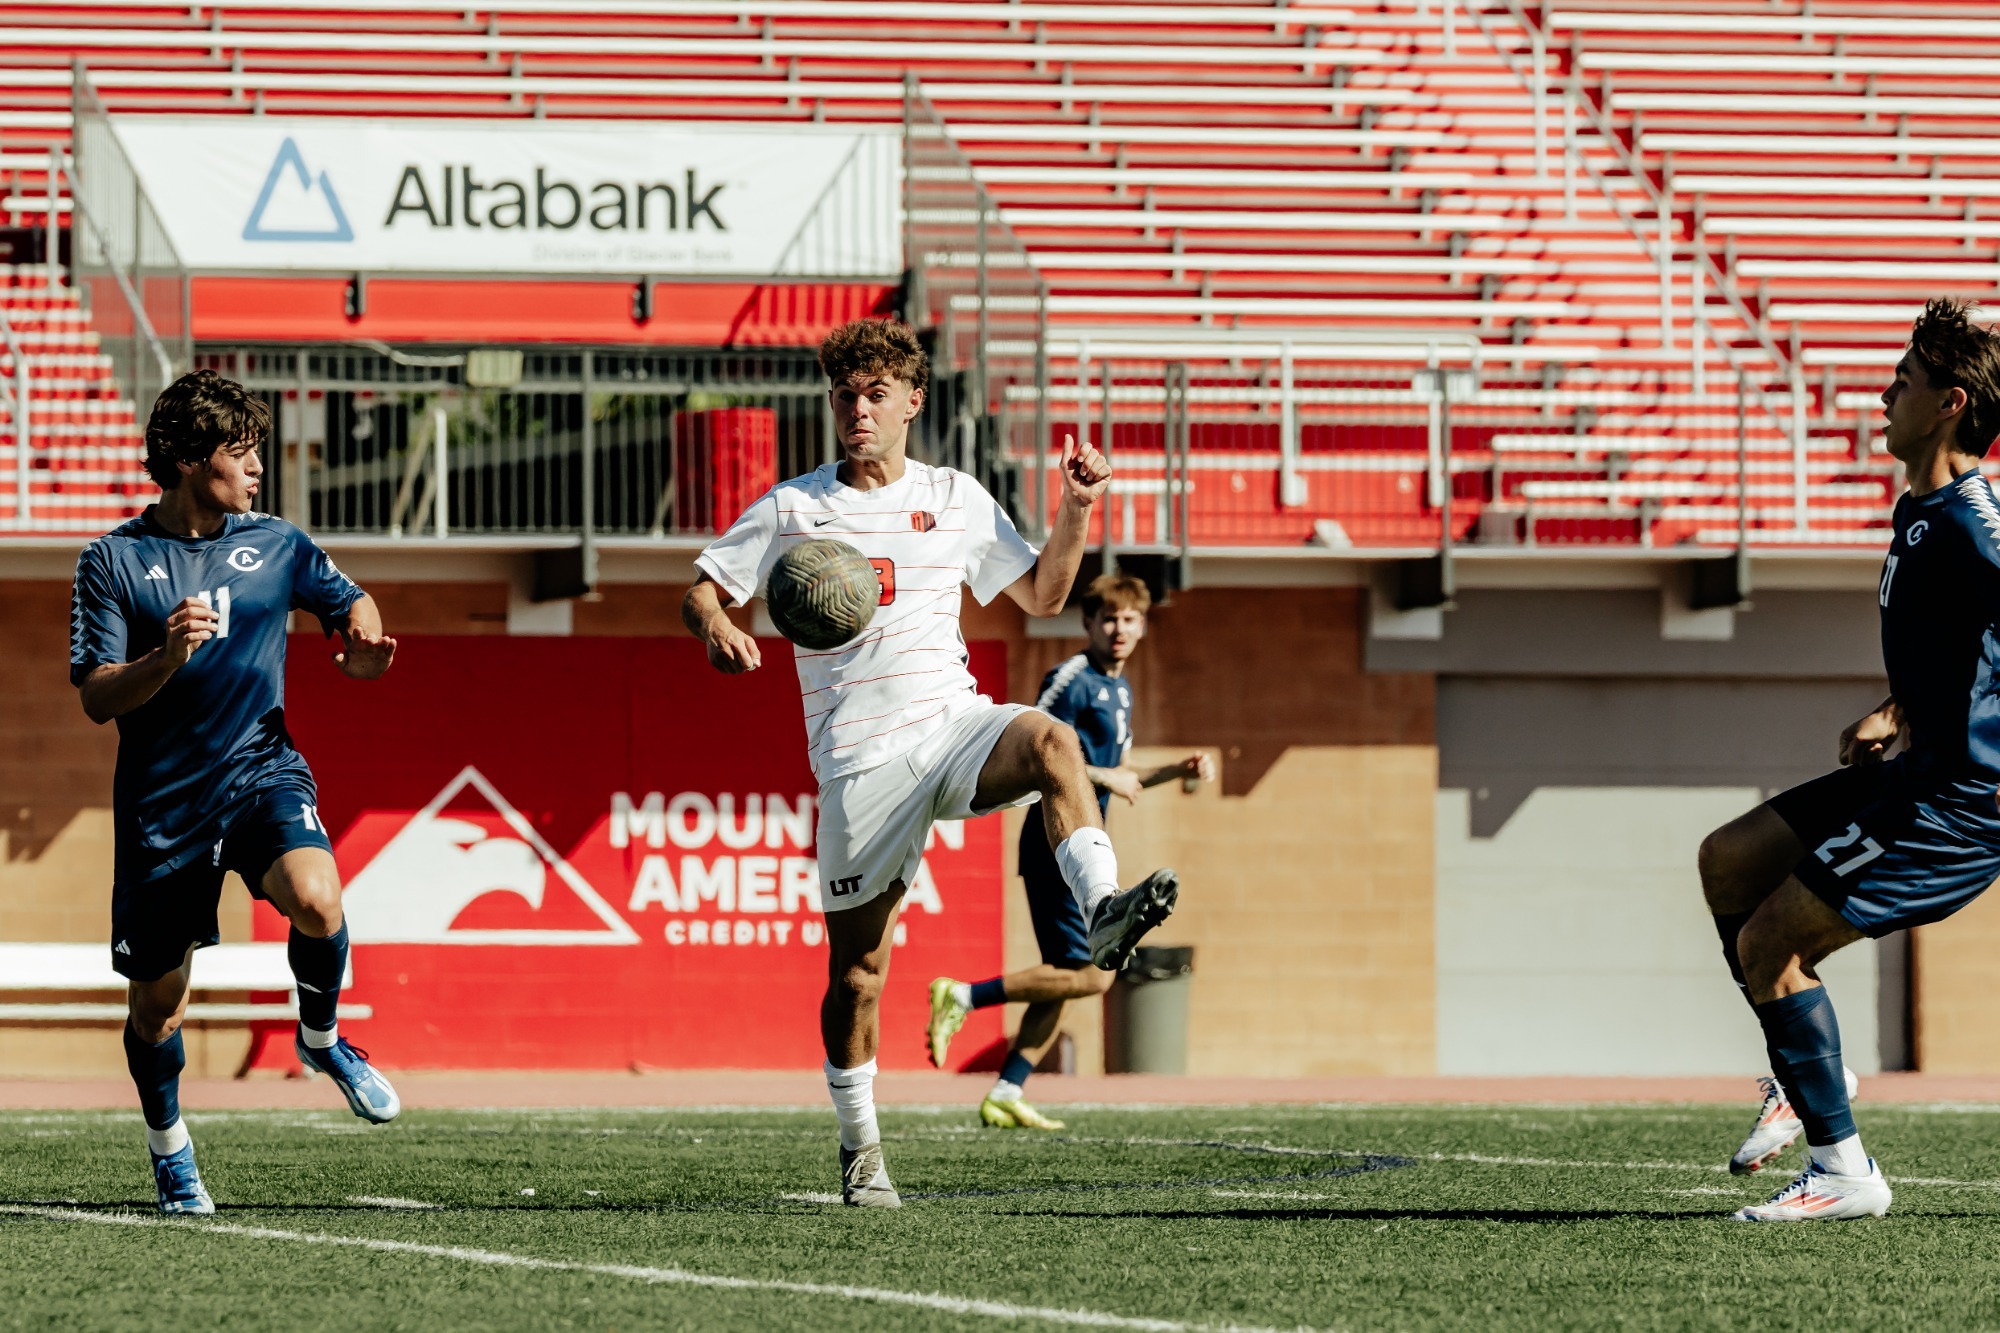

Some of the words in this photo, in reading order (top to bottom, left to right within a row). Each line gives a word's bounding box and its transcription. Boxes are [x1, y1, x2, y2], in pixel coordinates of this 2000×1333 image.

[384, 165, 728, 231] Altabank
[1814, 822, 1885, 877] 27
[628, 854, 944, 914] AMERA
[829, 873, 864, 897] UT
[664, 919, 793, 946] CREDIT
